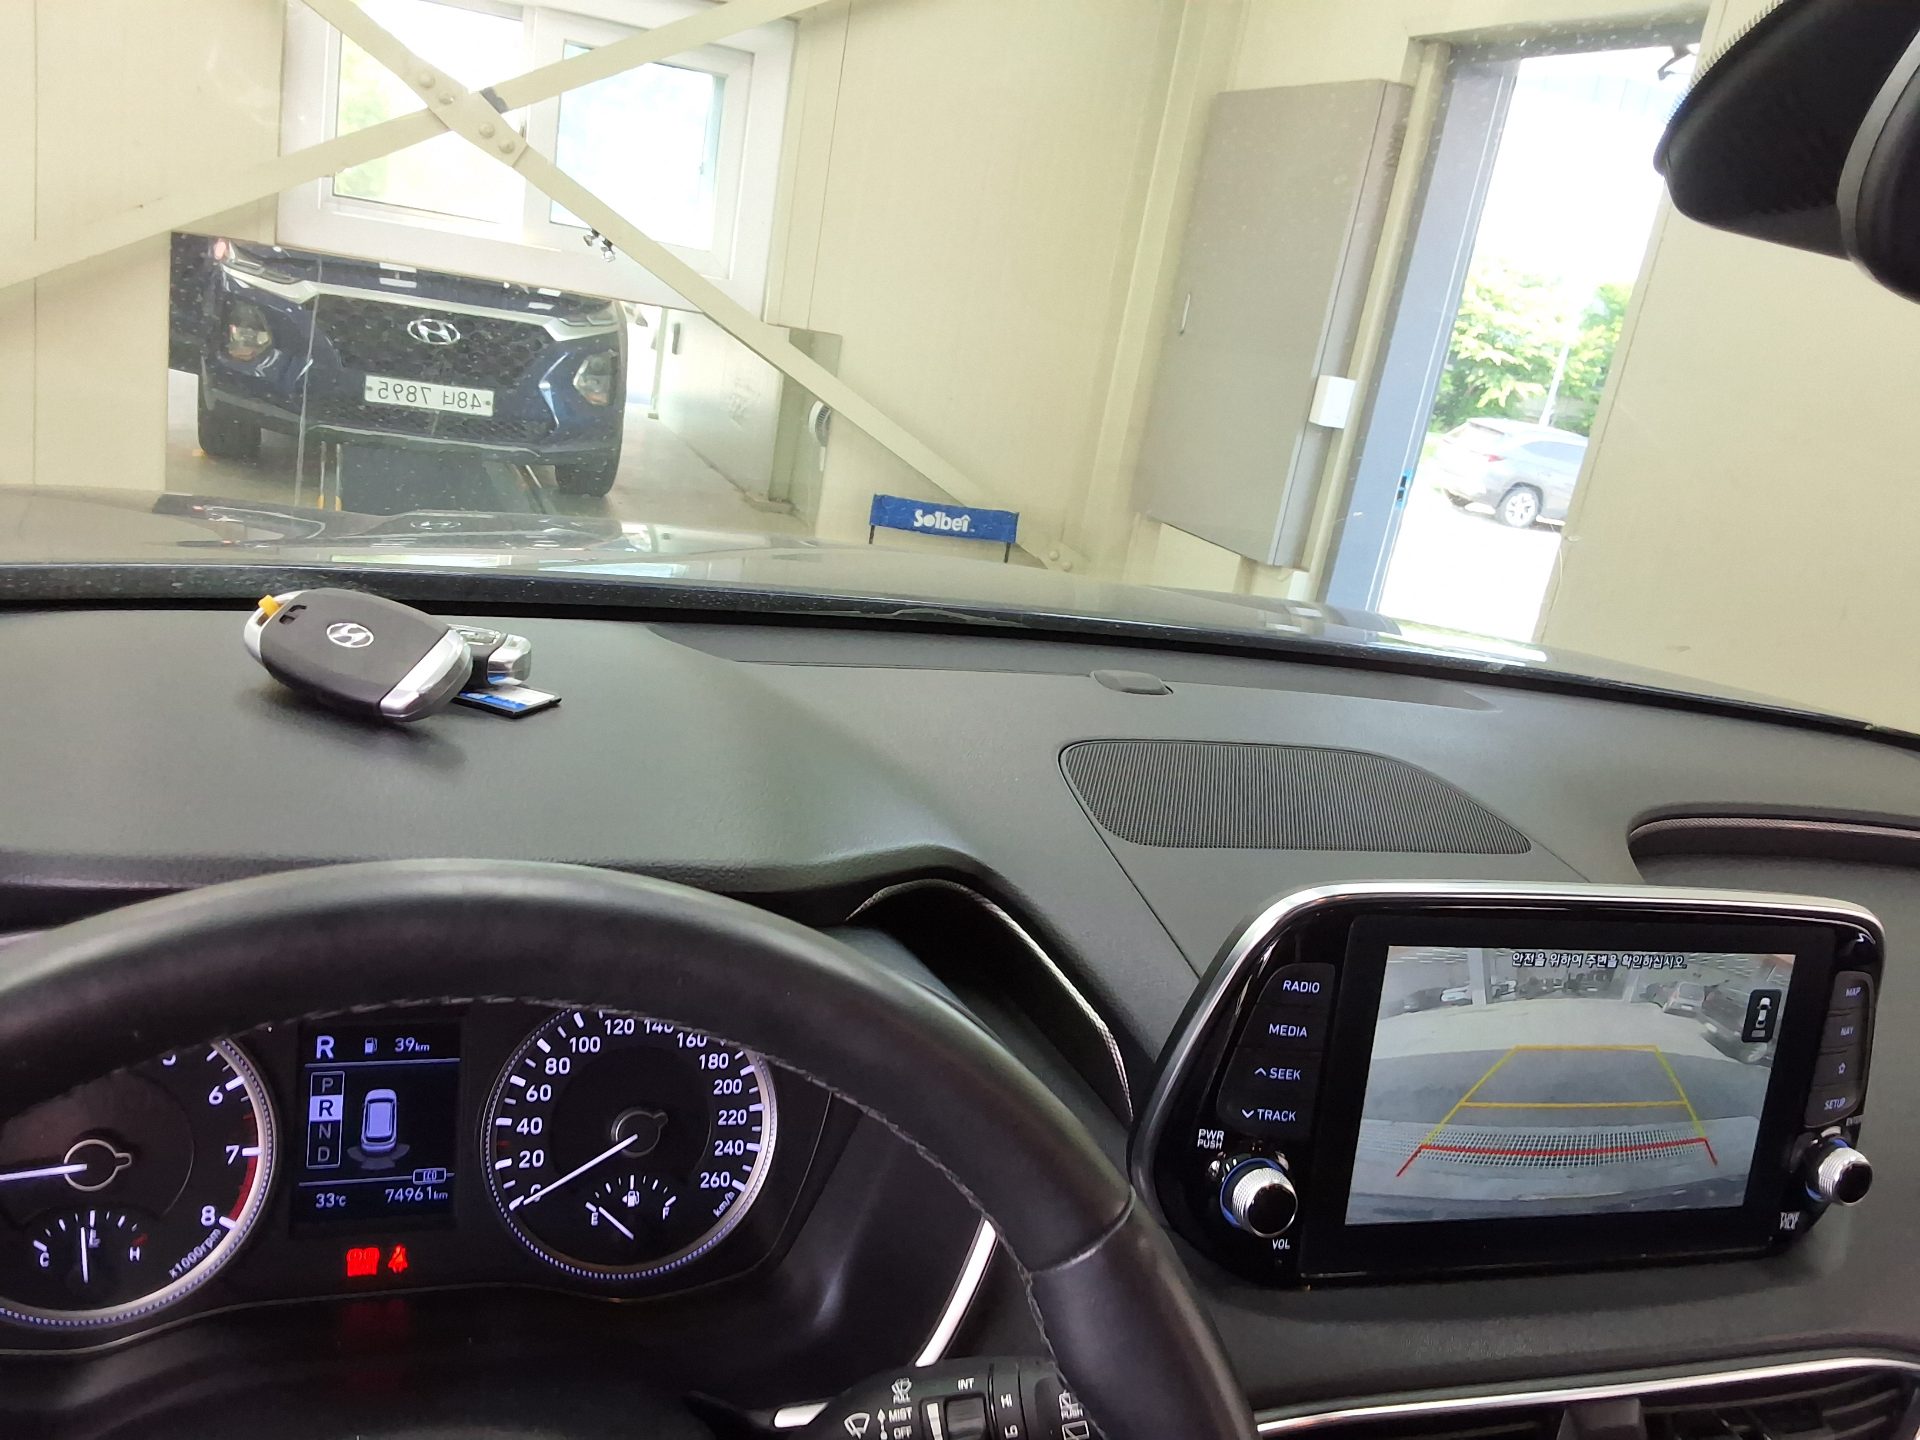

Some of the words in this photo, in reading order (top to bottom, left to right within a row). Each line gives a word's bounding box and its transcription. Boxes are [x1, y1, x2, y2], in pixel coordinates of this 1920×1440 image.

[1511, 951, 1547, 967] 안전을
[1549, 952, 1583, 968] 위하여
[1585, 953, 1619, 968] 주변을
[1282, 980, 1321, 994] RADIO
[604, 1018, 635, 1035] 120
[1268, 1023, 1309, 1038] MEDIA
[316, 1035, 335, 1059] R
[569, 1036, 600, 1053] 100
[676, 1032, 707, 1048] 160
[545, 1057, 570, 1075] 80
[699, 1053, 729, 1070] 180
[1269, 1067, 1301, 1081] SEEK
[321, 1077, 334, 1094] P
[526, 1084, 551, 1101] 60
[713, 1079, 742, 1095] 200
[208, 1085, 224, 1105] 6
[318, 1099, 334, 1117] R
[1257, 1108, 1297, 1122] TRACK
[516, 1117, 543, 1135] 40
[717, 1109, 747, 1126] 220
[318, 1123, 332, 1139] N
[1198, 1128, 1225, 1141] PWR
[714, 1139, 744, 1156] 240
[1197, 1139, 1223, 1150] PUSH
[225, 1145, 240, 1165] 7
[317, 1145, 330, 1163] D
[518, 1150, 545, 1169] 20
[700, 1171, 730, 1188] 260
[712, 1190, 736, 1218] km/h
[201, 1205, 216, 1227] 8
[590, 1211, 599, 1226] E
[662, 1206, 670, 1220] F
[1272, 1238, 1291, 1250] VOL
[39, 1252, 50, 1268] C
[129, 1246, 141, 1261] H
[957, 1377, 975, 1391] INT
[1000, 1393, 1013, 1409] HI
